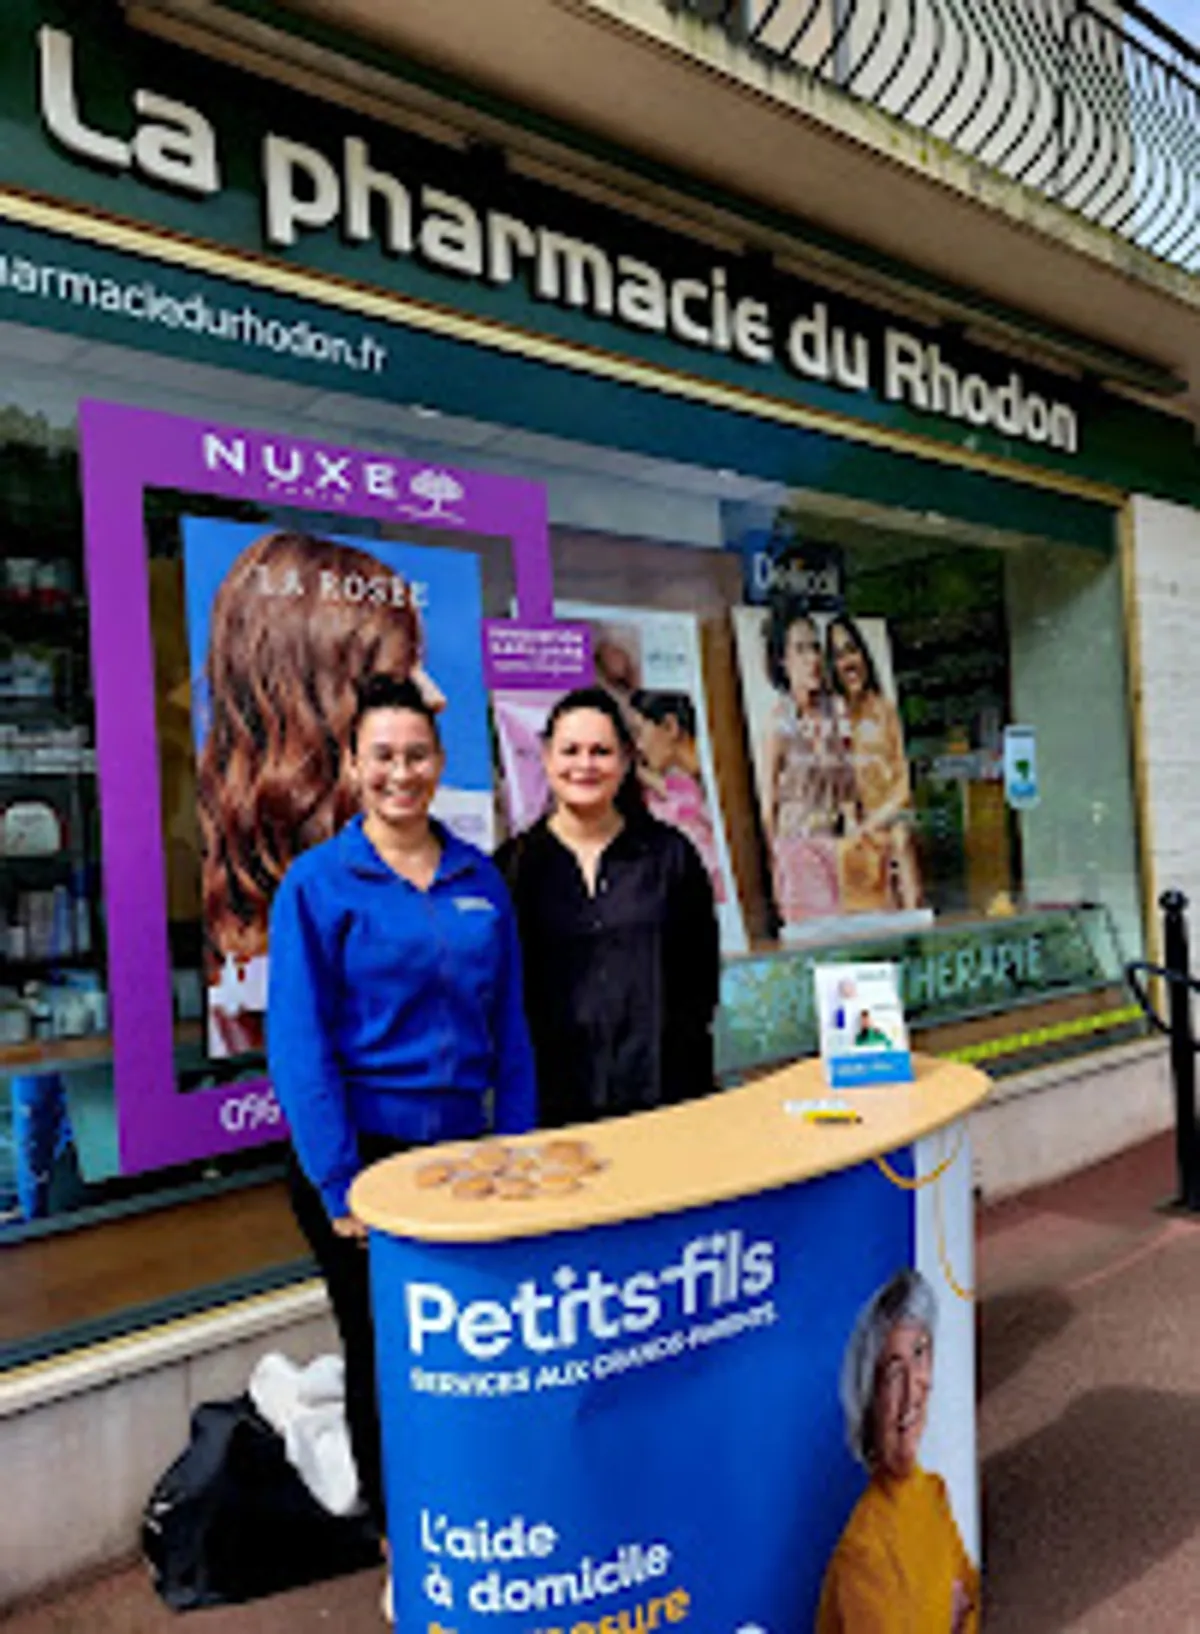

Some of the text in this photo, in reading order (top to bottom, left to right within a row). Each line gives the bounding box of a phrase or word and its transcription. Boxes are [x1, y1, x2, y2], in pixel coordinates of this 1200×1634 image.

[37, 25, 1078, 453] La pharmacie du Rhodon
[203, 433, 399, 498] NUXE
[405, 1229, 776, 1361] Petits-fils
[420, 1508, 556, 1562] L'aide
[423, 1543, 672, 1614] à domicile
